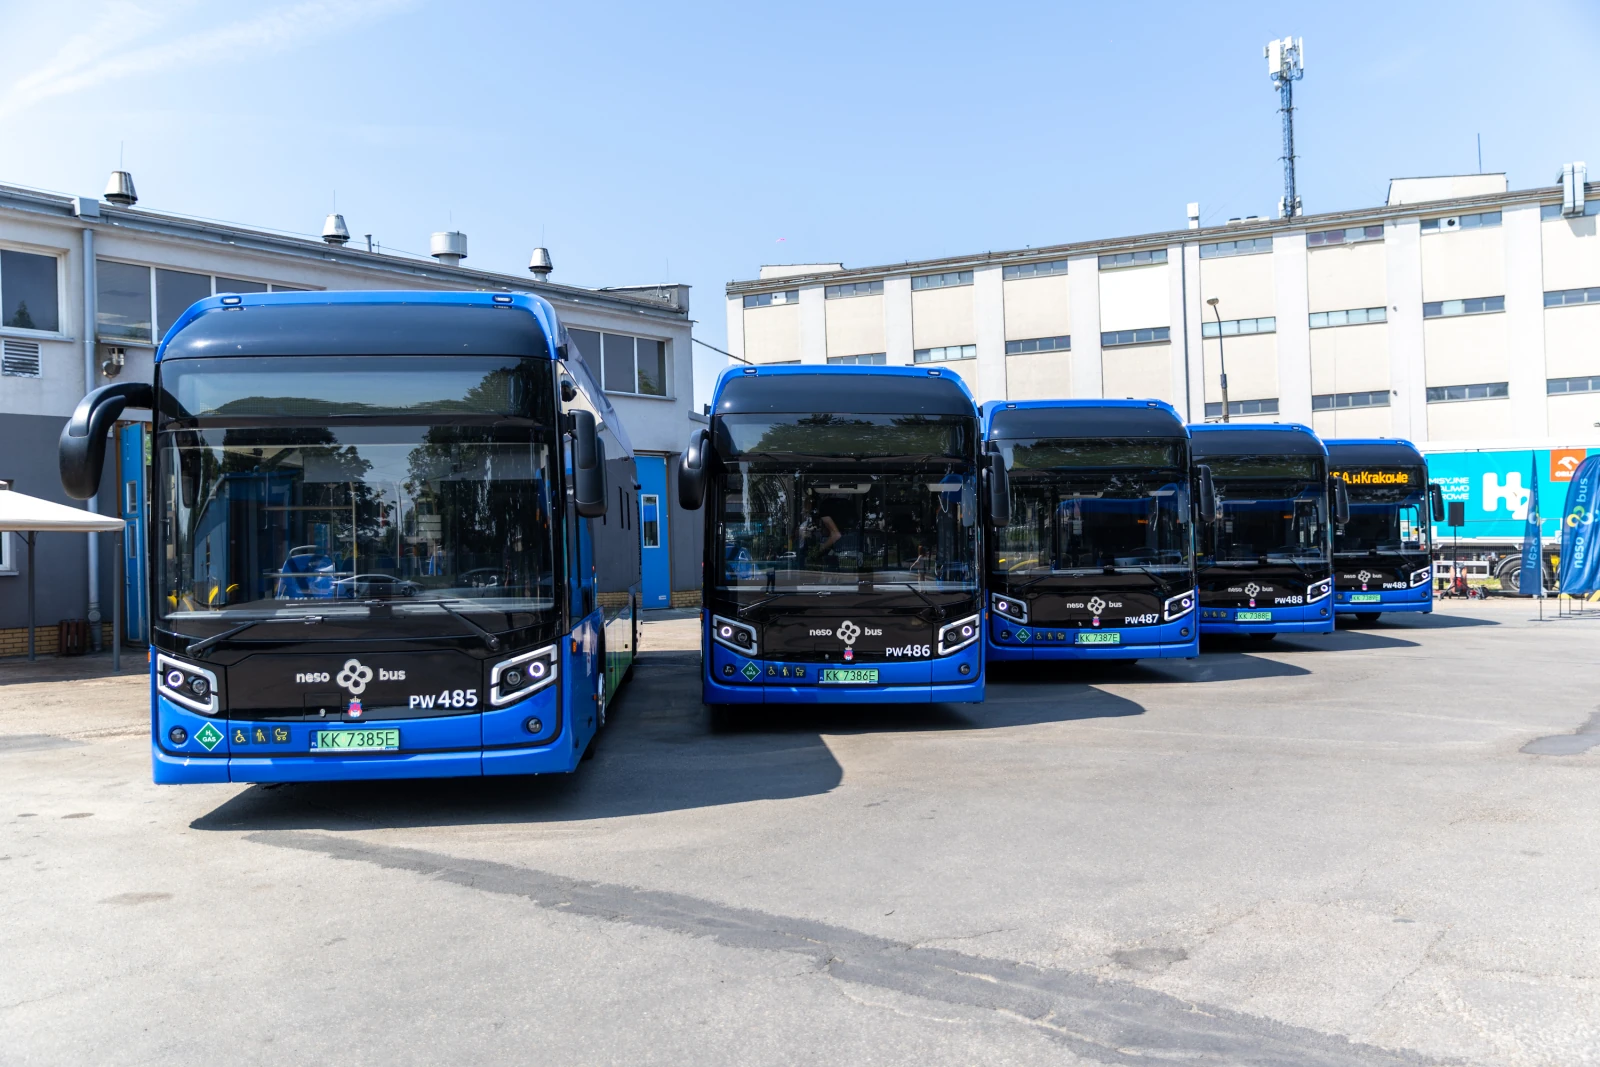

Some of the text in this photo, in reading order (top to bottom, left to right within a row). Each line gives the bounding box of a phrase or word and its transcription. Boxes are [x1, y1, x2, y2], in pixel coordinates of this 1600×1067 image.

[1361, 472, 1408, 484] Krakowie
[1428, 477, 1470, 485] MISYJNE
[1574, 478, 1588, 569] neso bus
[1274, 596, 1302, 604] PW488
[1125, 614, 1159, 624] PW487
[809, 626, 882, 636] neso bus
[1080, 633, 1118, 642] KK 7387E
[886, 644, 931, 657] PW486
[296, 668, 406, 682] neso bus
[825, 670, 840, 680] KK
[844, 670, 876, 680] 7386E
[409, 688, 478, 709] PW485
[321, 732, 340, 747] KK
[347, 732, 395, 746] 7385E
